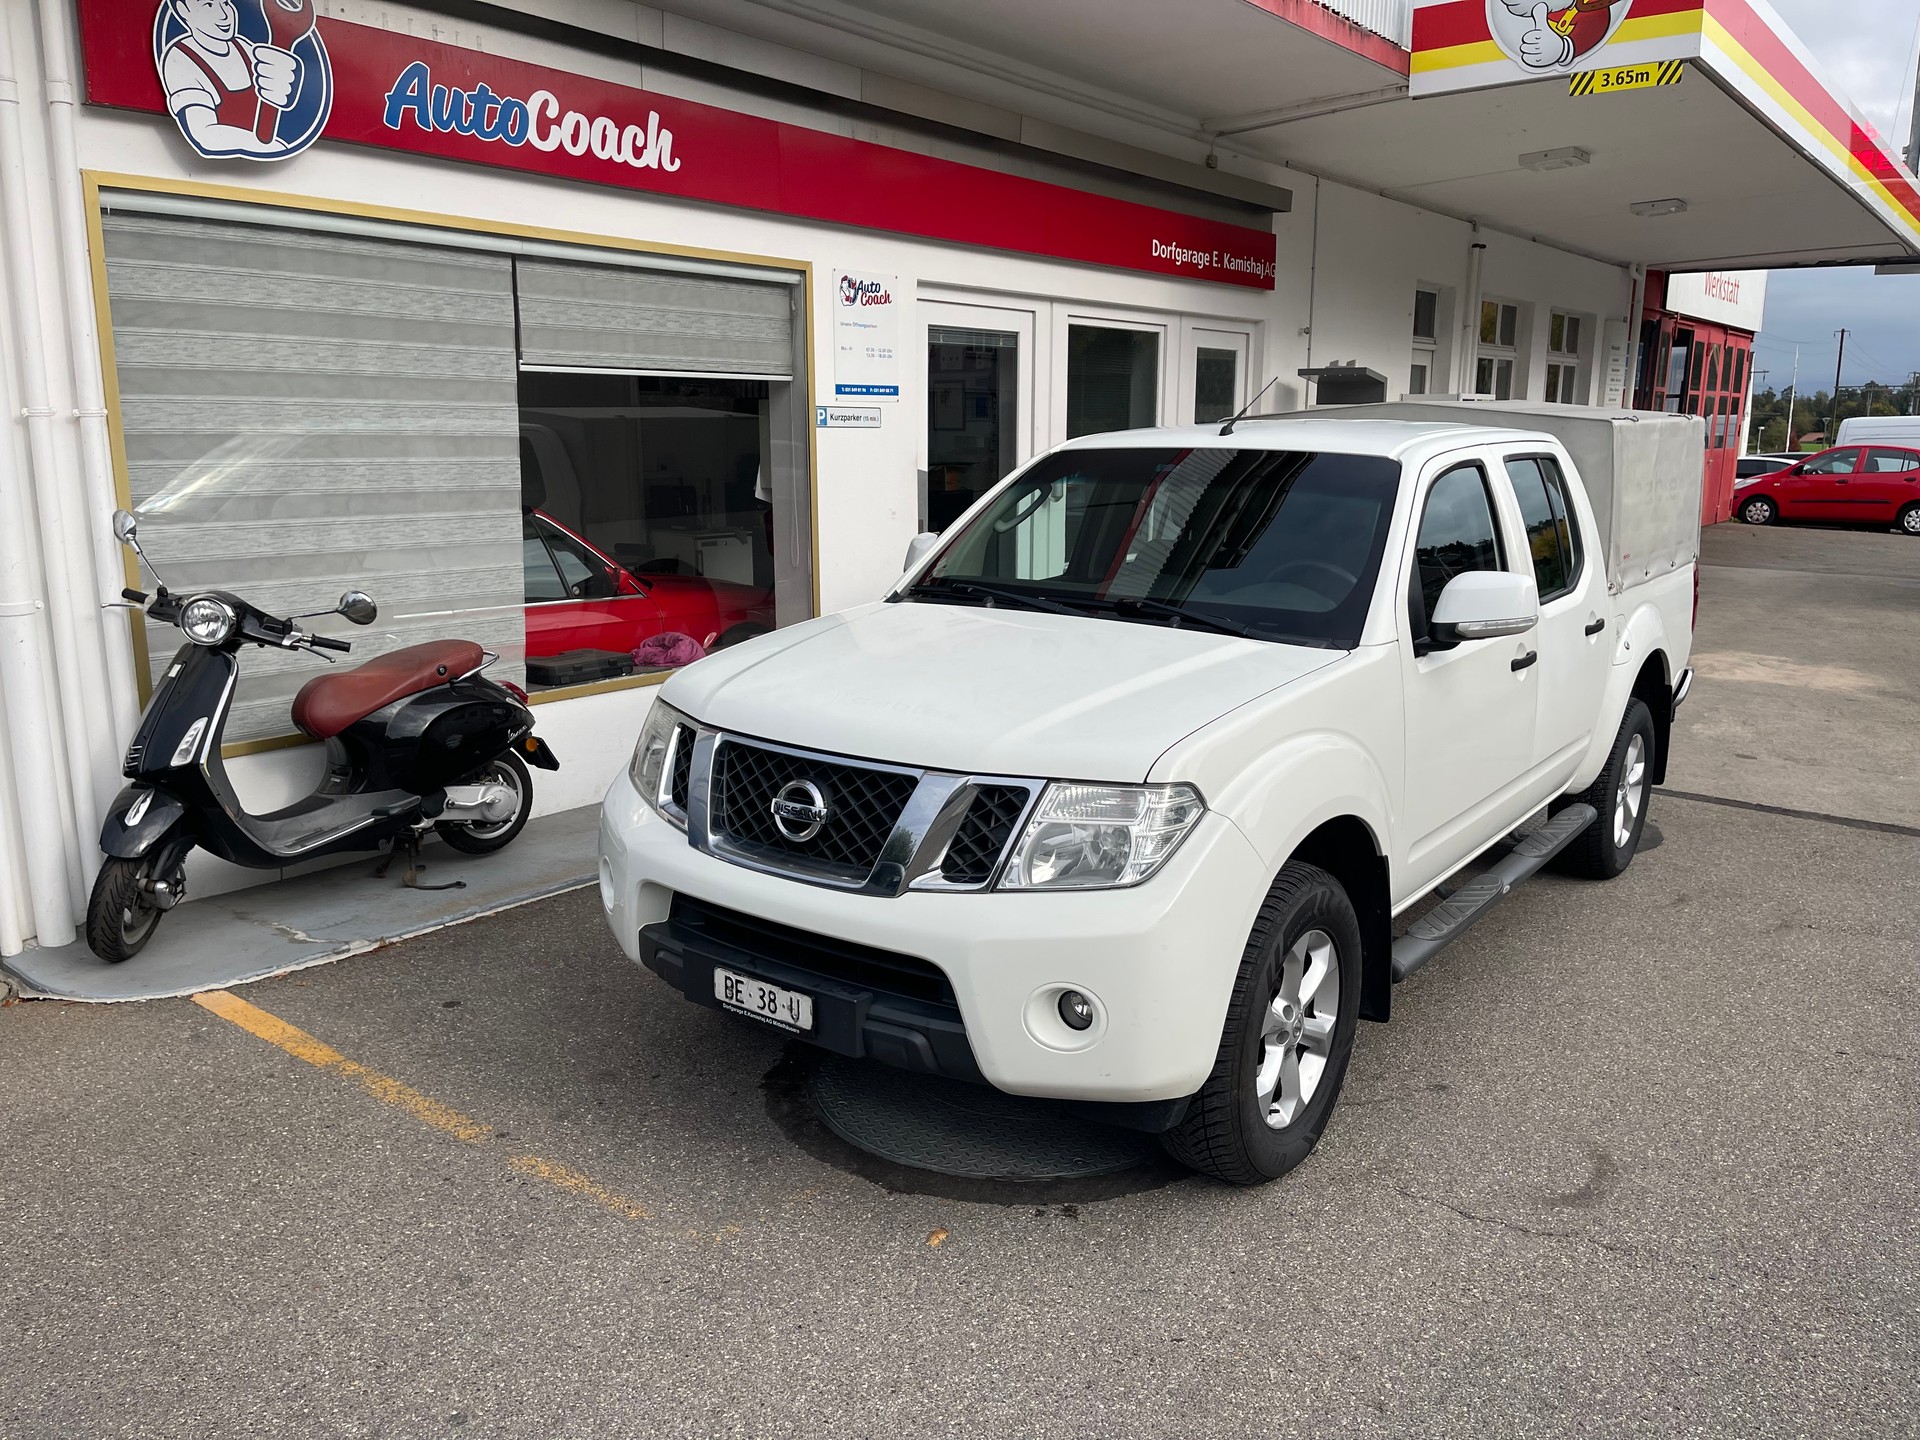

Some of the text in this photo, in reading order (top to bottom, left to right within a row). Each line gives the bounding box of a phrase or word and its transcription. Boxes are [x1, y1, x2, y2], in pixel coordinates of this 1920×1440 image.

[1601, 70, 1650, 87] 3.65m
[1152, 239, 1210, 269] Dorfgarage
[1212, 251, 1221, 267] E.
[857, 280, 881, 294] Auto
[1704, 272, 1740, 305] Werkstatt
[860, 290, 892, 306] Coach
[816, 409, 826, 425] P
[829, 413, 862, 423] Kurzparker
[773, 801, 818, 820] NISSAN
